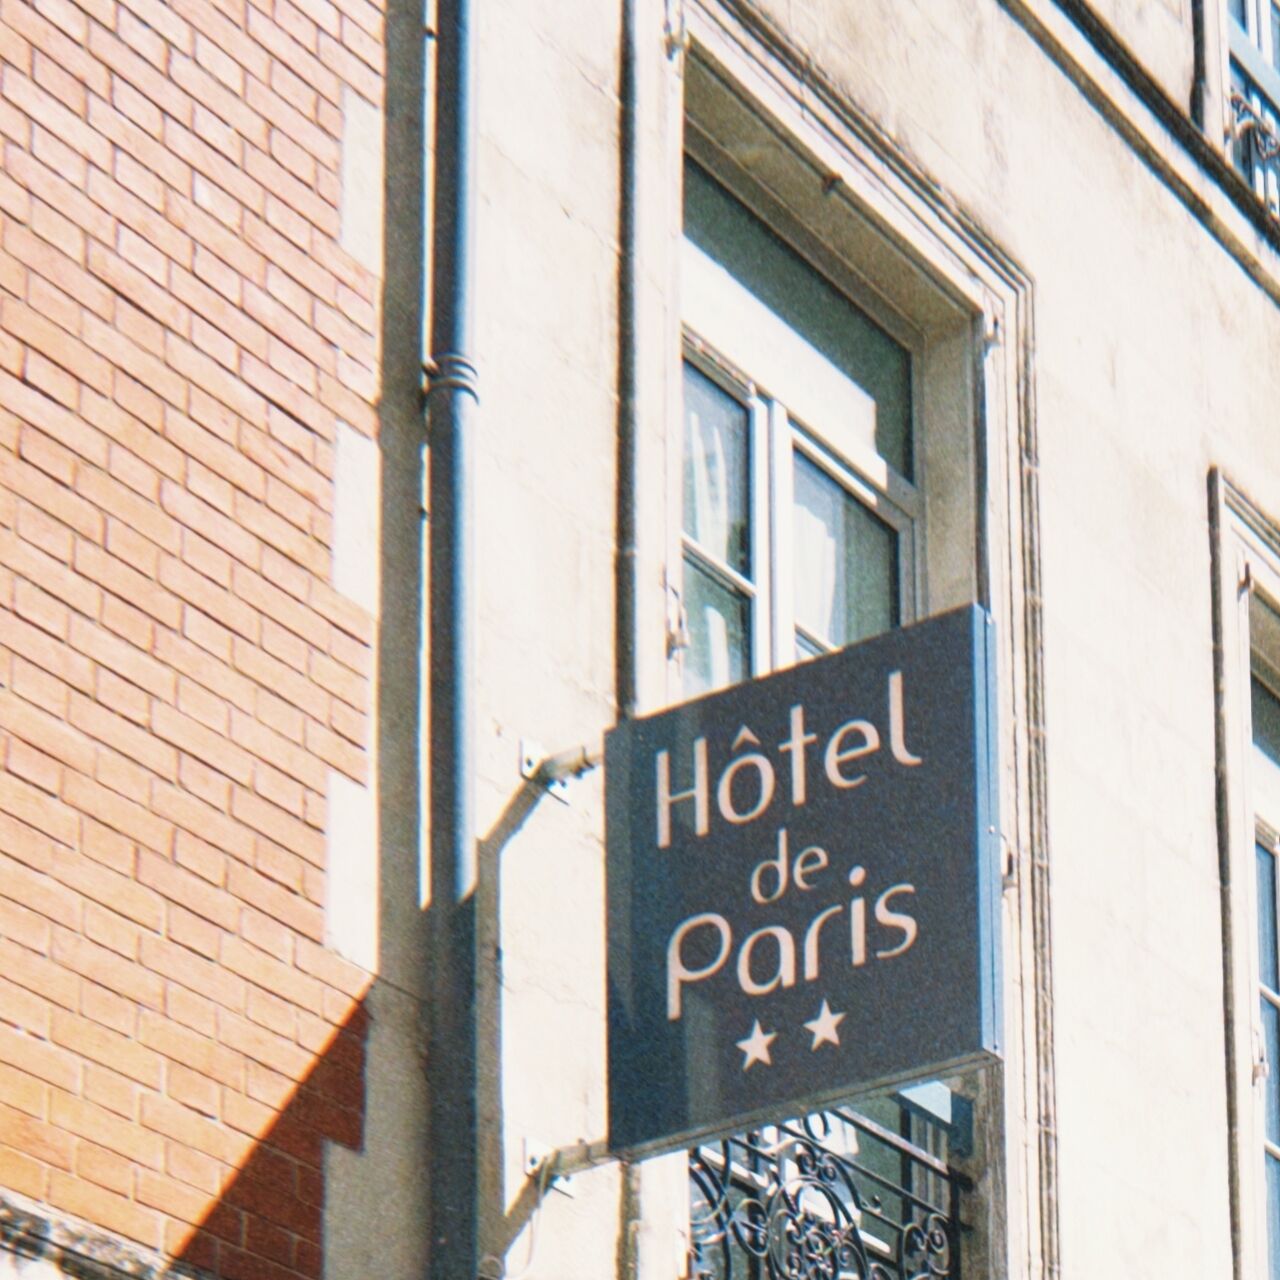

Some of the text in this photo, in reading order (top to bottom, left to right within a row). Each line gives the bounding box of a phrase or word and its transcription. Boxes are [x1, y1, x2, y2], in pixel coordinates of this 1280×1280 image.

[655, 670, 922, 849] Hôtel
[666, 865, 919, 1021] Paris
[750, 827, 829, 904] de
